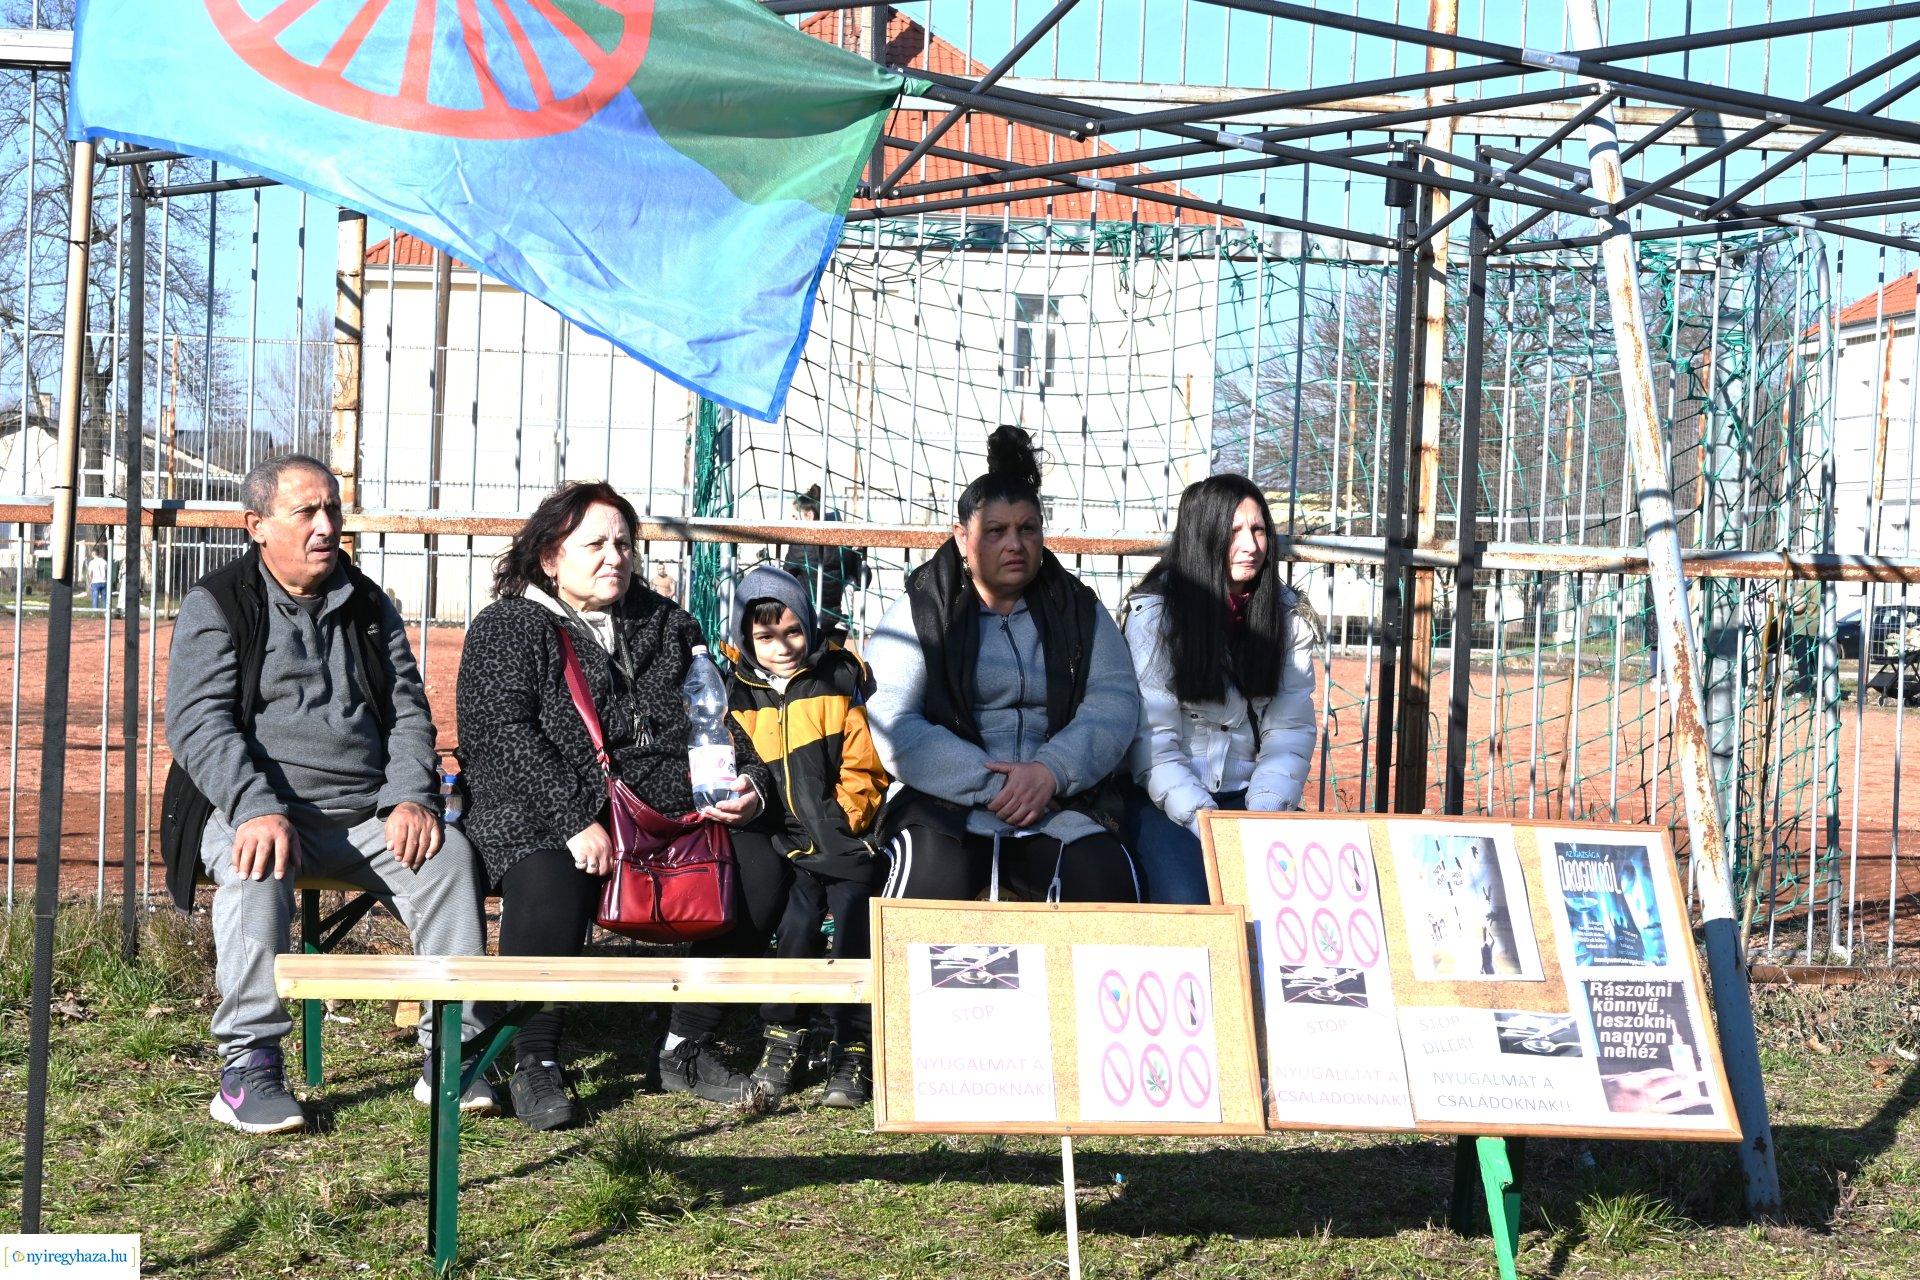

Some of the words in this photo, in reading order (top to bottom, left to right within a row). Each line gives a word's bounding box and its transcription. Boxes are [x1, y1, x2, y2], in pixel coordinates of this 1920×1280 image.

[1590, 981, 1673, 998] Rászokni
[951, 1004, 995, 1023] STOP
[1592, 997, 1665, 1016] könnyű,
[1306, 1018, 1348, 1034] STOP
[1419, 1014, 1461, 1032] STOP
[1596, 1013, 1672, 1029] leszokni
[1422, 1036, 1475, 1055] DILER!
[1600, 1031, 1667, 1047] nagyon
[1603, 1043, 1659, 1059] nehéz
[916, 1057, 1028, 1071] NYUGALMAT
[1032, 1058, 1045, 1072] A
[1275, 1065, 1383, 1082] NYUGALMAT
[1388, 1071, 1399, 1083] A
[1433, 1071, 1537, 1089] NYUGALMAT
[1543, 1076, 1554, 1090] A
